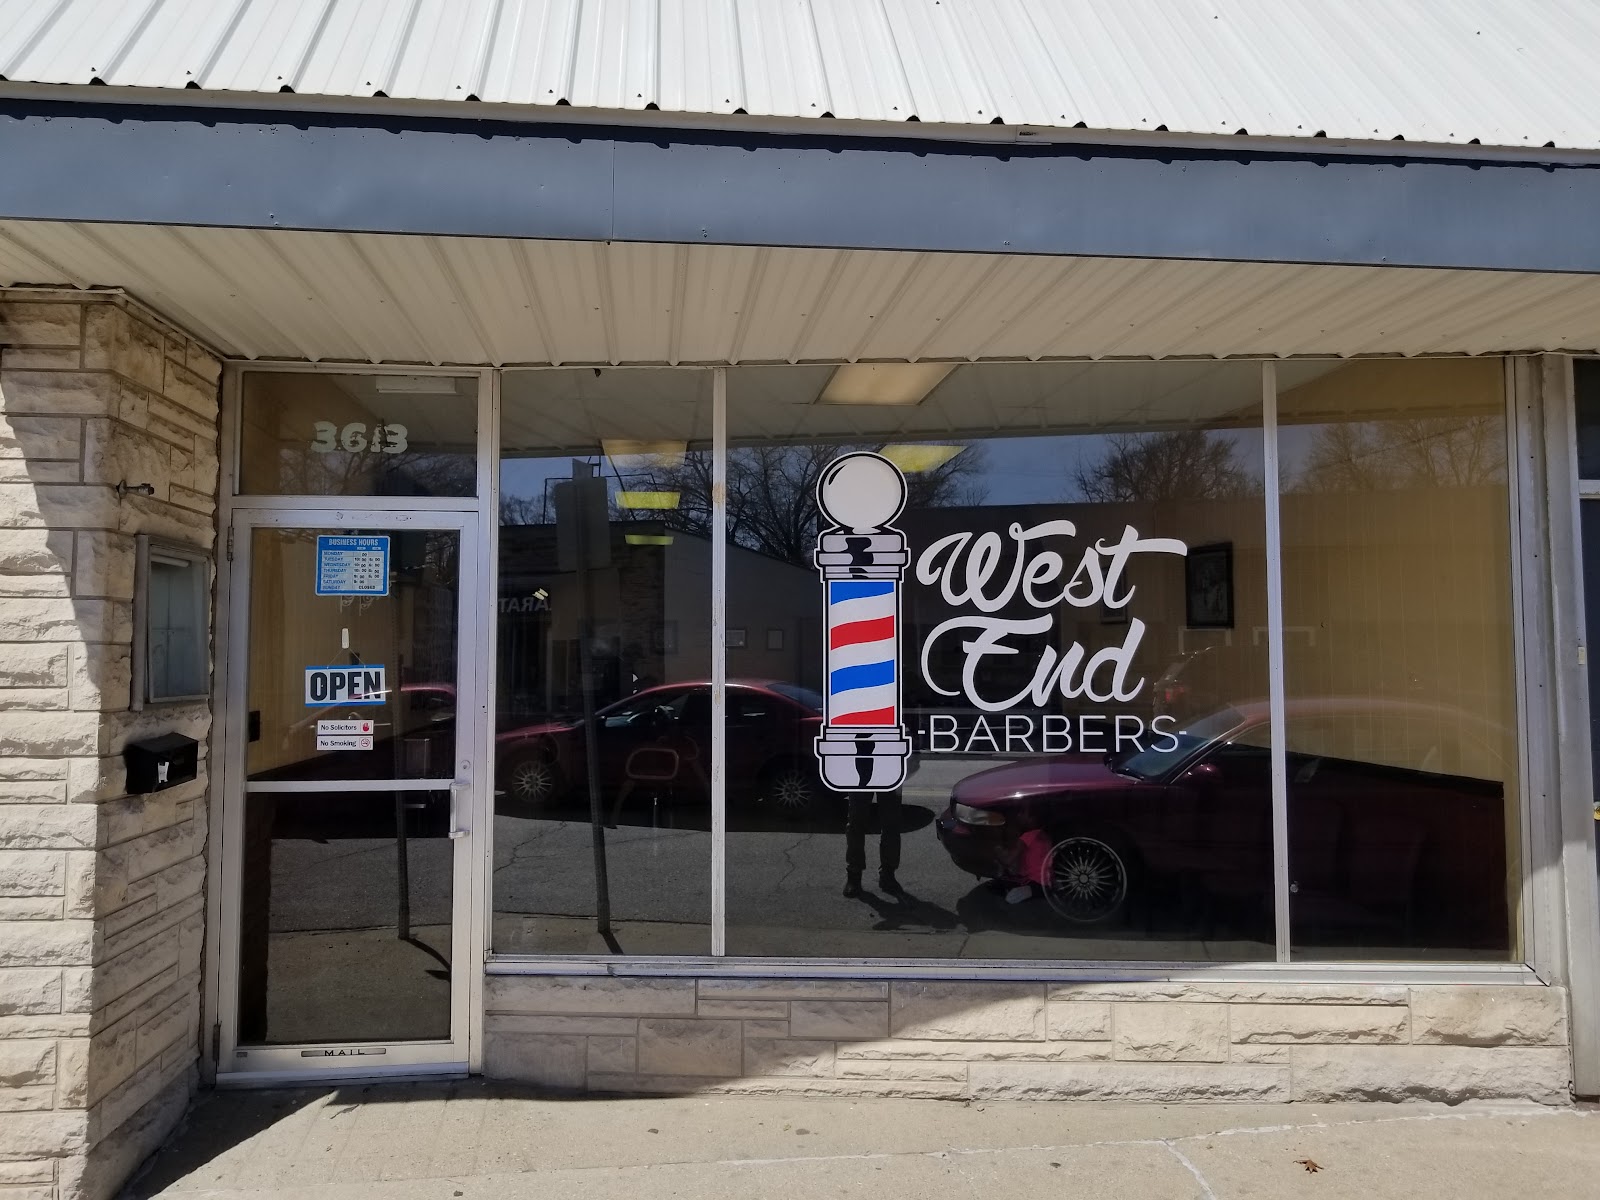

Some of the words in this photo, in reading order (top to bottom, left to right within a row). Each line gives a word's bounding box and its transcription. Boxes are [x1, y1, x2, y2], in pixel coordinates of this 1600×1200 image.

[310, 420, 408, 454] 3613
[328, 538, 357, 546] BUSINESS
[358, 538, 379, 546] HOURS
[915, 519, 1188, 613] West
[921, 612, 1146, 712] End
[310, 671, 381, 702] OPEN
[324, 1048, 365, 1057] MAIL
